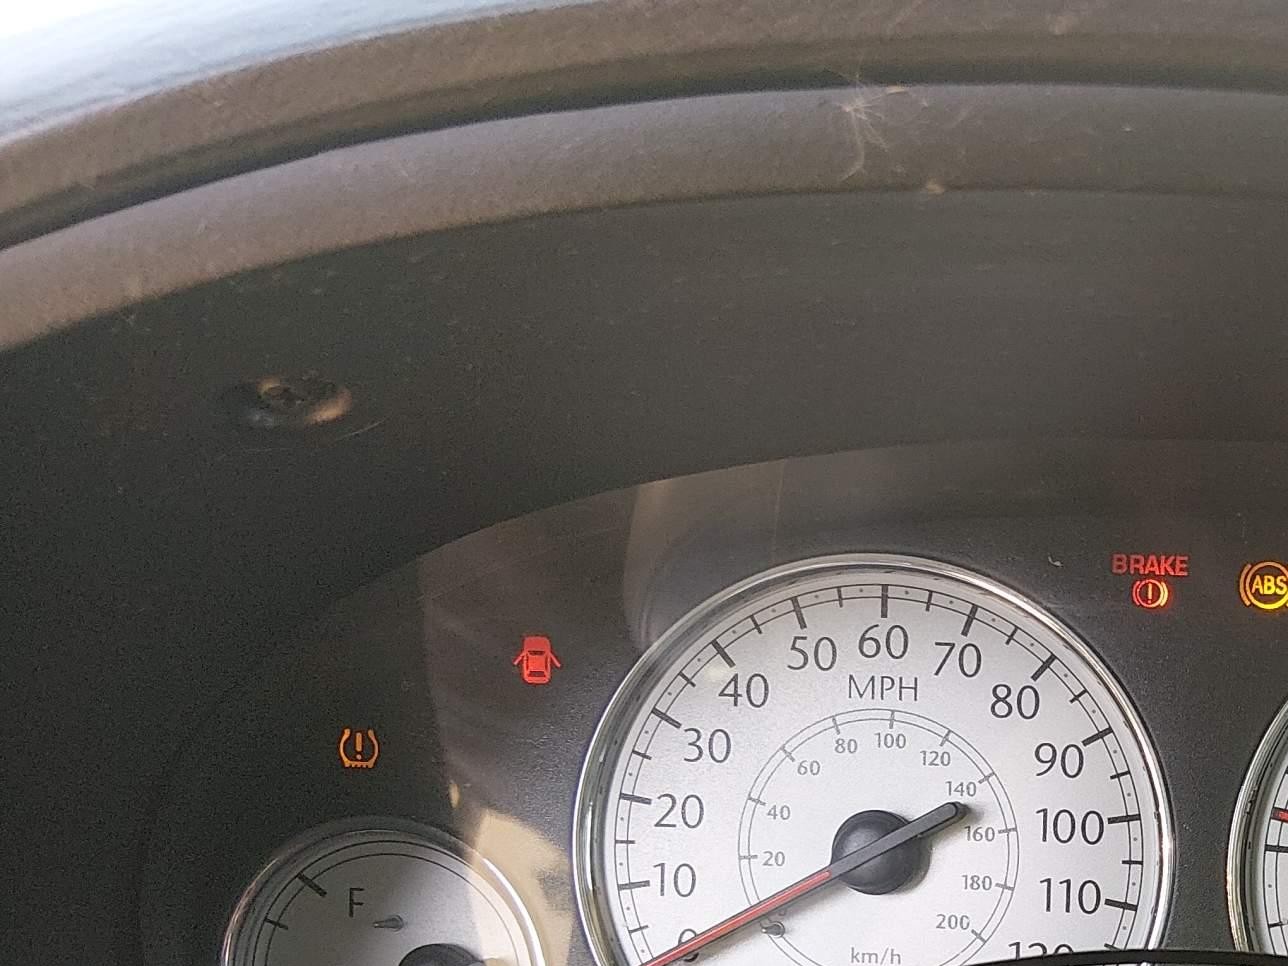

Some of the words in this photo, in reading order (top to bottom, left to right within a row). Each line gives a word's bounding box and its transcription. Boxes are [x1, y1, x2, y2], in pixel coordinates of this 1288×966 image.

[1110, 553, 1190, 577] BRAKE
[1250, 574, 1288, 596] ABS
[787, 636, 838, 672] 50
[858, 624, 909, 660] 60
[934, 641, 982, 678] 70
[718, 673, 769, 709] 40
[848, 675, 918, 702] MPH
[990, 684, 1040, 720] 80
[683, 727, 732, 764] 30
[834, 738, 858, 755] 80
[874, 730, 907, 750] 100
[796, 759, 822, 776] 60
[919, 750, 951, 768] 120
[1034, 742, 1084, 779] 90
[945, 780, 978, 798] 140
[653, 793, 705, 829] 20
[766, 803, 791, 821] 40
[963, 824, 996, 843] 160
[1035, 808, 1105, 846] 100
[761, 850, 786, 868] 20
[653, 862, 697, 898] 10
[962, 874, 993, 891] 180
[348, 887, 365, 919] F
[1039, 878, 1102, 915] 110
[935, 913, 971, 932] 200
[850, 946, 902, 966] km/h
